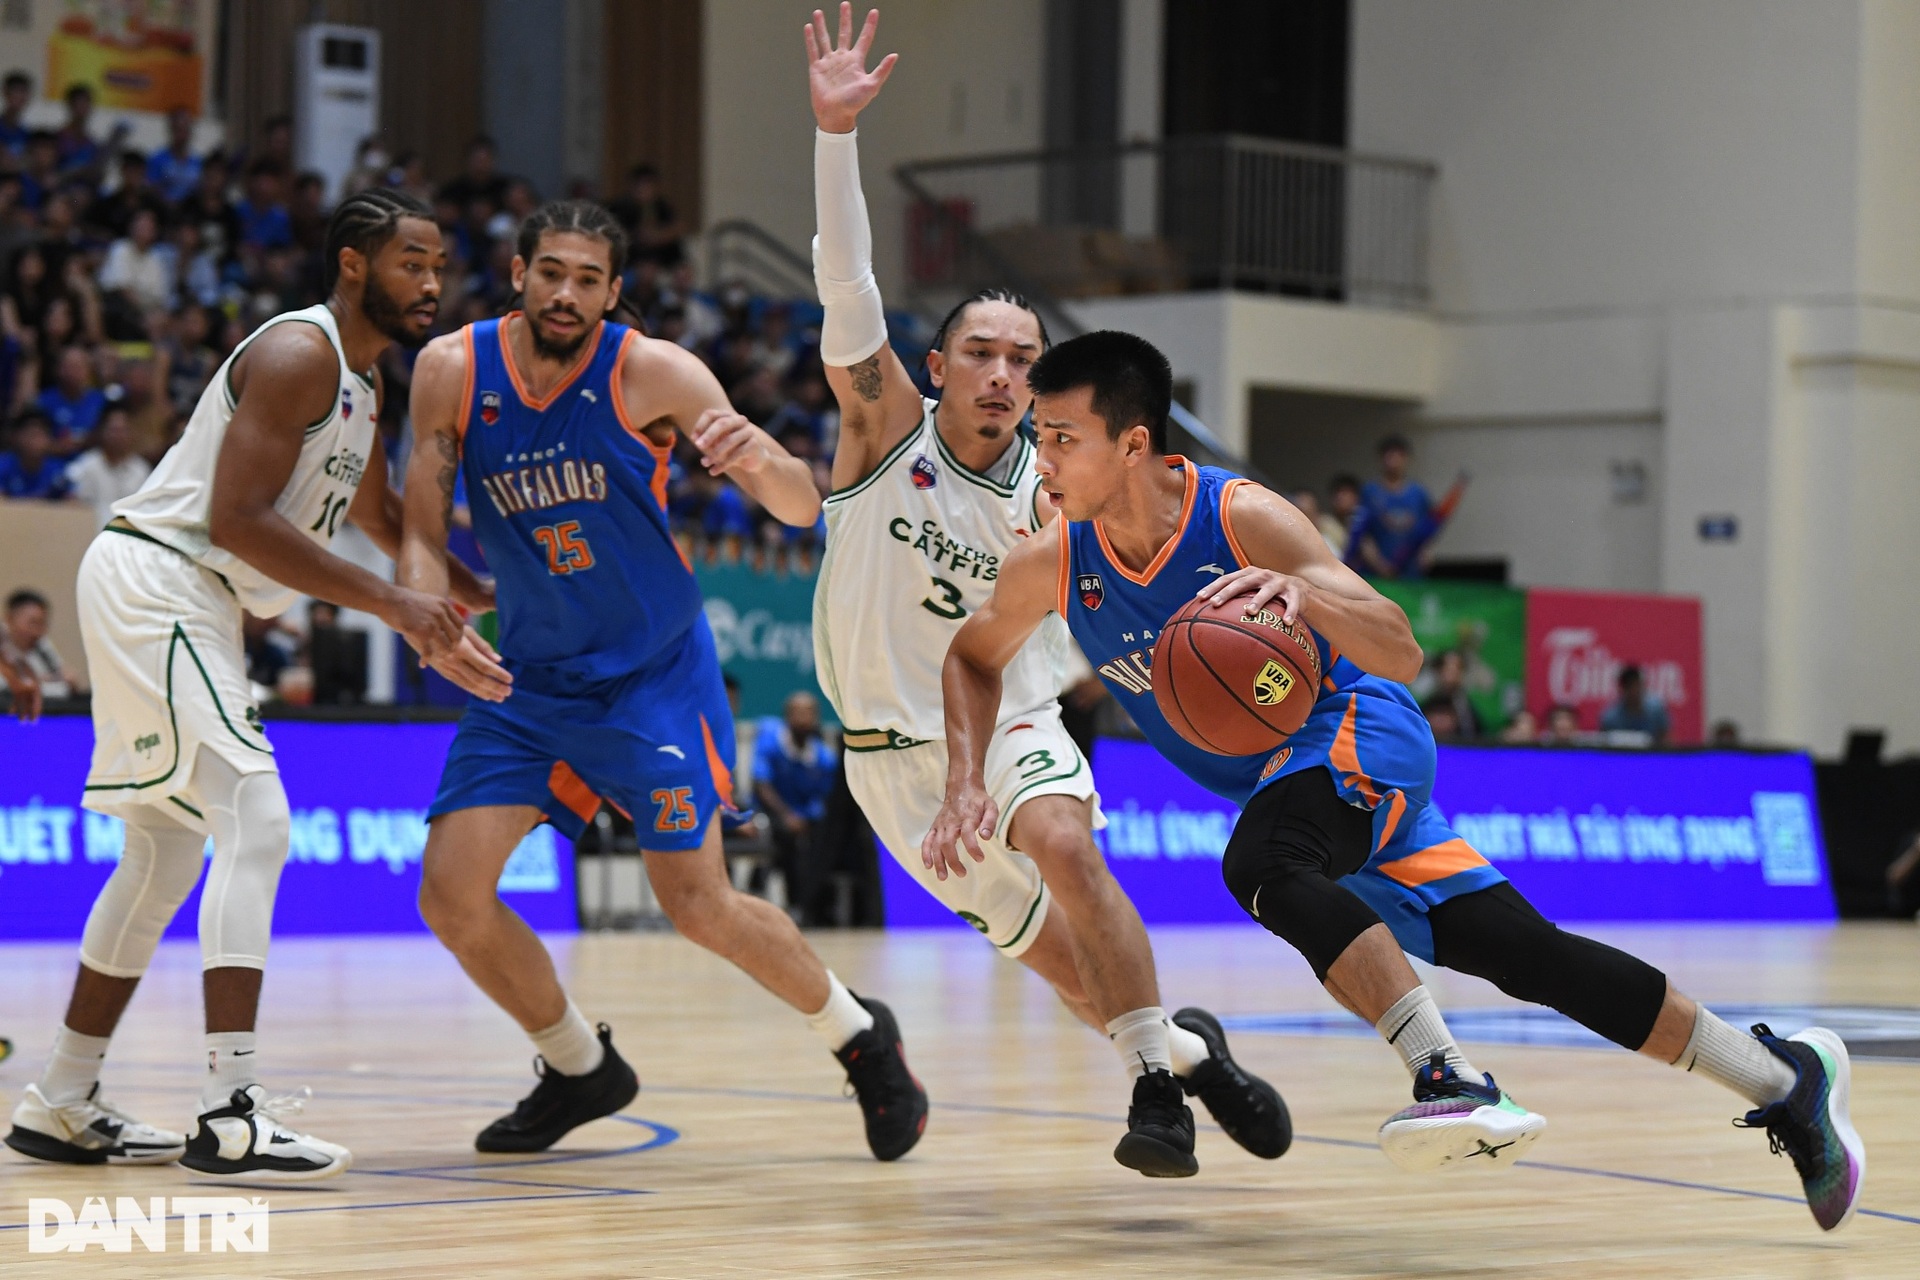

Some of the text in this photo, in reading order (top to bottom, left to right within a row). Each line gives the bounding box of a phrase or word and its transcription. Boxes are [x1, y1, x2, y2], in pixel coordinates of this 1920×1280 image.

[532, 519, 596, 576] 25
[889, 517, 998, 581] CATFIS
[922, 520, 999, 565] CANTHO
[921, 576, 967, 620] 3
[1122, 629, 1163, 642] HA
[1265, 664, 1290, 691] VBA
[1016, 749, 1056, 780] 3
[650, 785, 699, 833] 25
